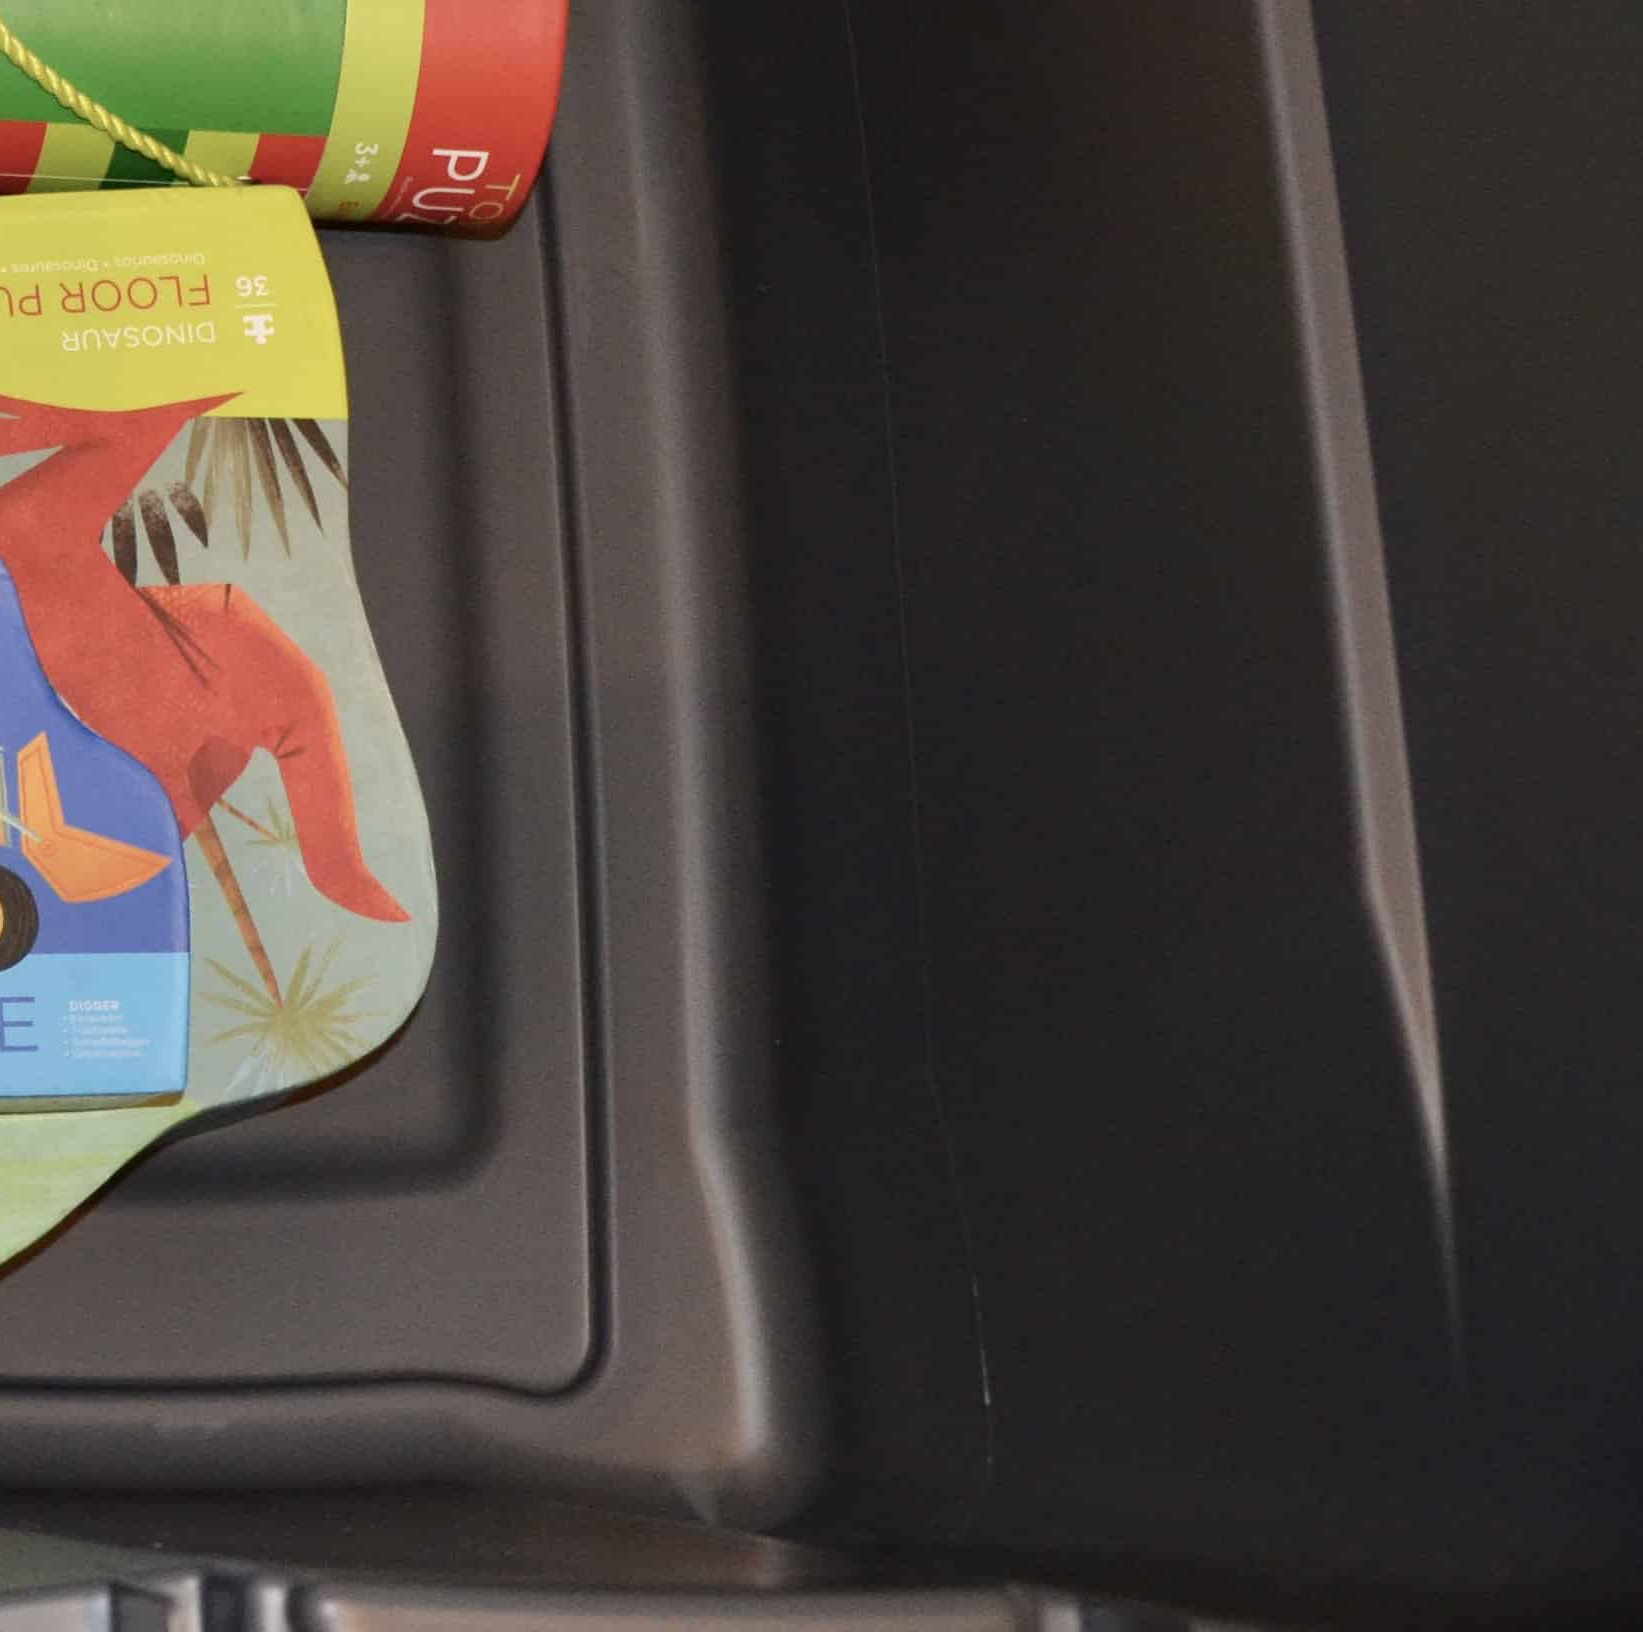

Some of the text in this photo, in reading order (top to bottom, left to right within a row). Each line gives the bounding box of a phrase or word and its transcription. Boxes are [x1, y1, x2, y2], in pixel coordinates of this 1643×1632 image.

[355, 143, 380, 168] 3+
[58, 273, 212, 314] FLOOR
[236, 274, 268, 297] 36
[61, 320, 217, 353] DINOSAUR
